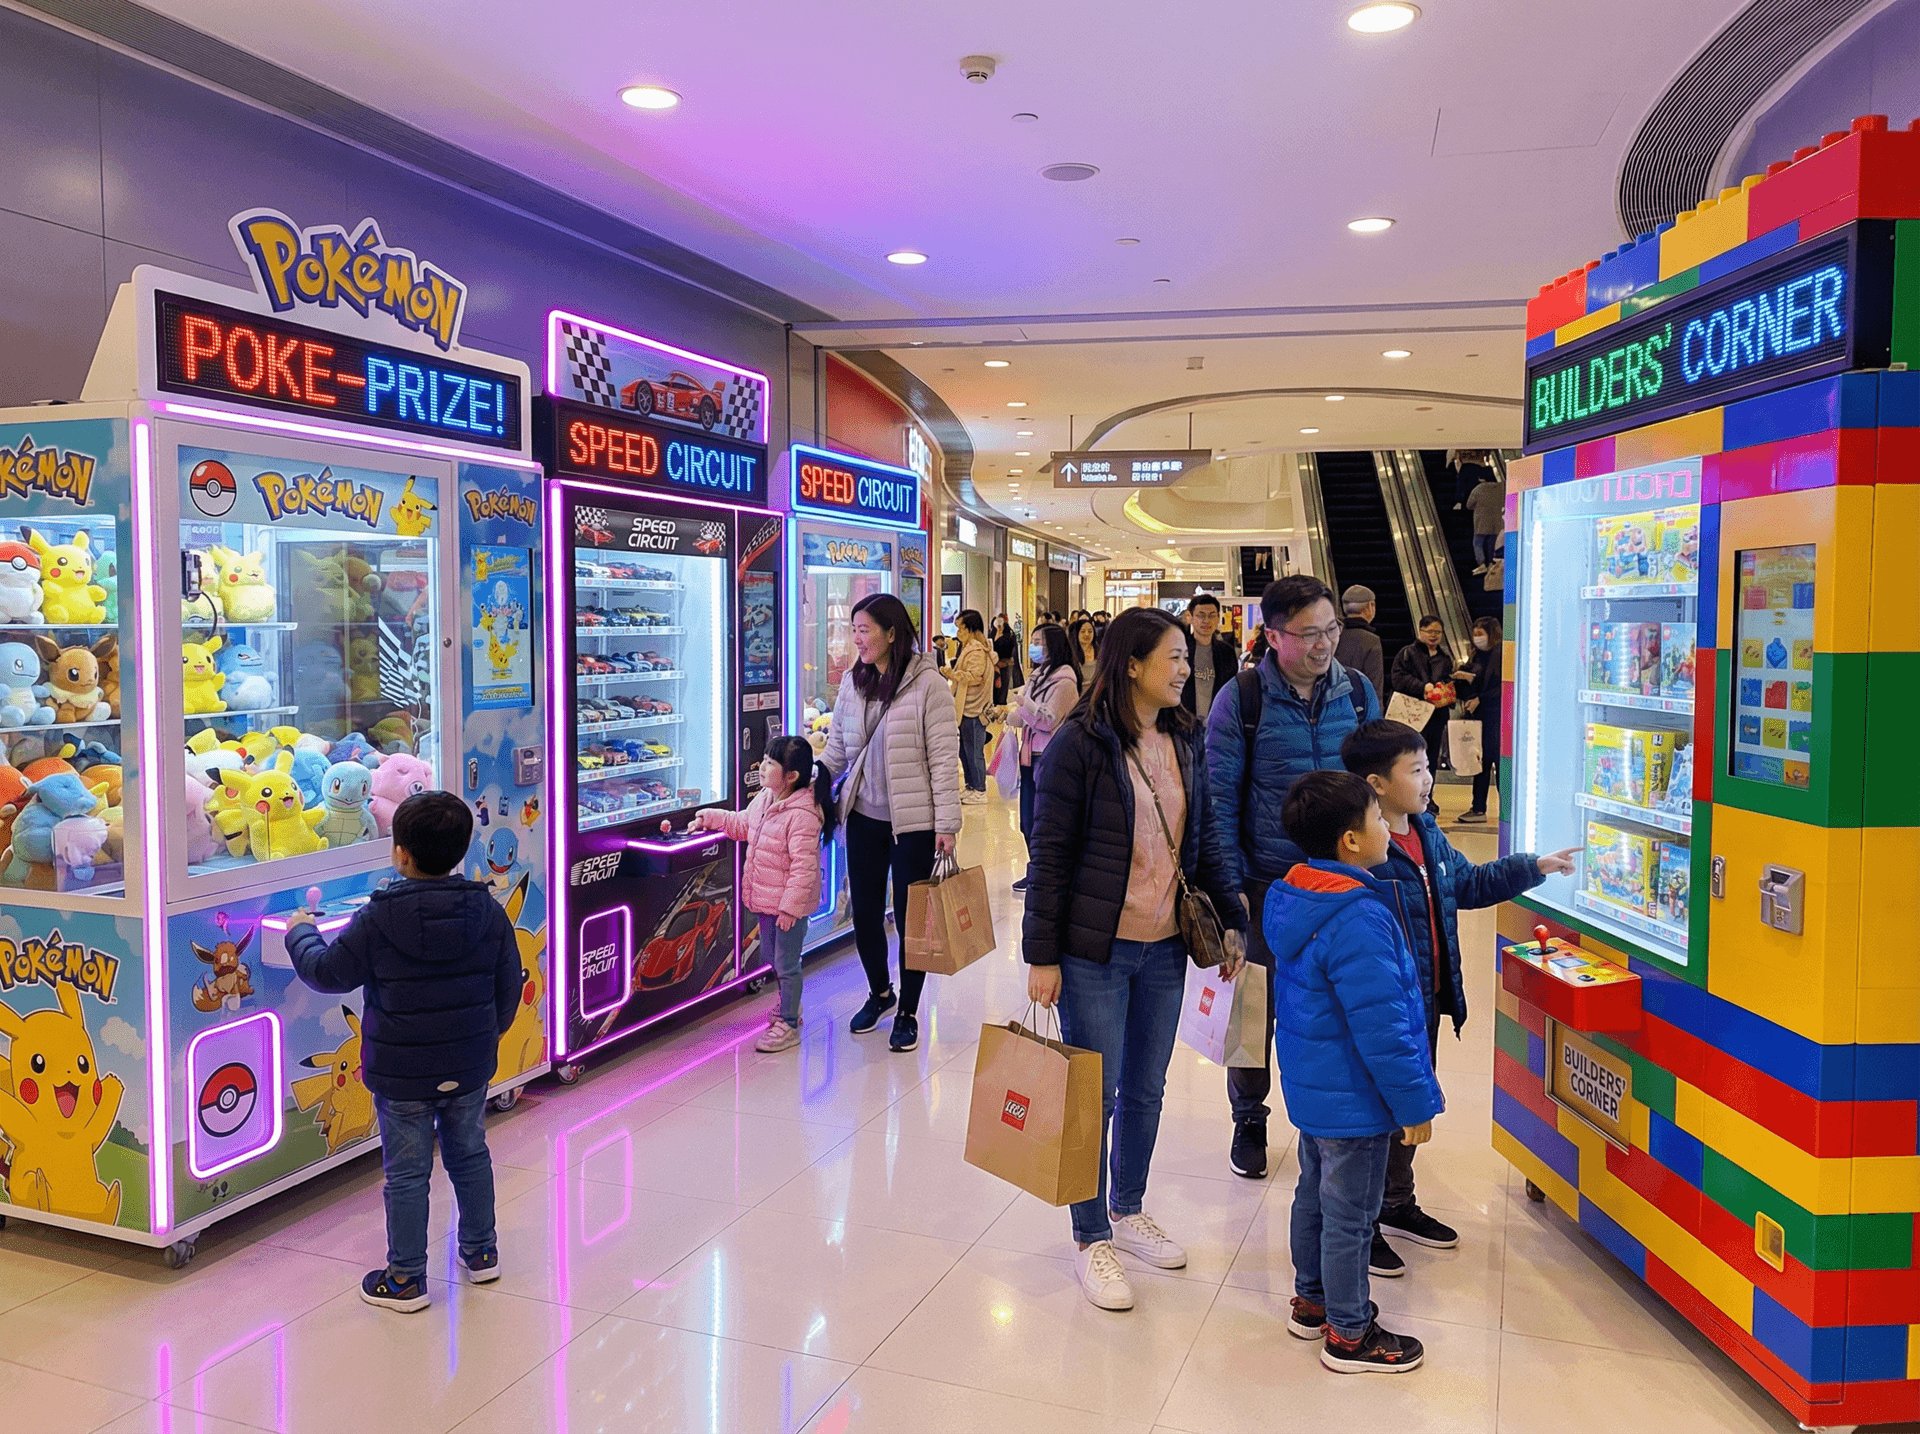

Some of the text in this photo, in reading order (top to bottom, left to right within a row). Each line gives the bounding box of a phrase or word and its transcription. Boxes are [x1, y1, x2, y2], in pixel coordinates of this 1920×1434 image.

[1682, 264, 1846, 384] CORNER
[184, 314, 506, 436] POKE-PRIZE!
[569, 421, 758, 493] SPEED CIRCUIT
[800, 463, 914, 514] SPEED CIRCUIT
[627, 533, 680, 551] CIRCUIT
[631, 517, 676, 535] SPEED
[580, 865, 619, 885] CIRCUIT
[582, 851, 622, 873] SPEED
[582, 943, 616, 965] SPEED
[582, 956, 618, 979] CIRCUIT
[1564, 1044, 1626, 1099] BUILDERS'
[1570, 1072, 1619, 1120] CORNER
